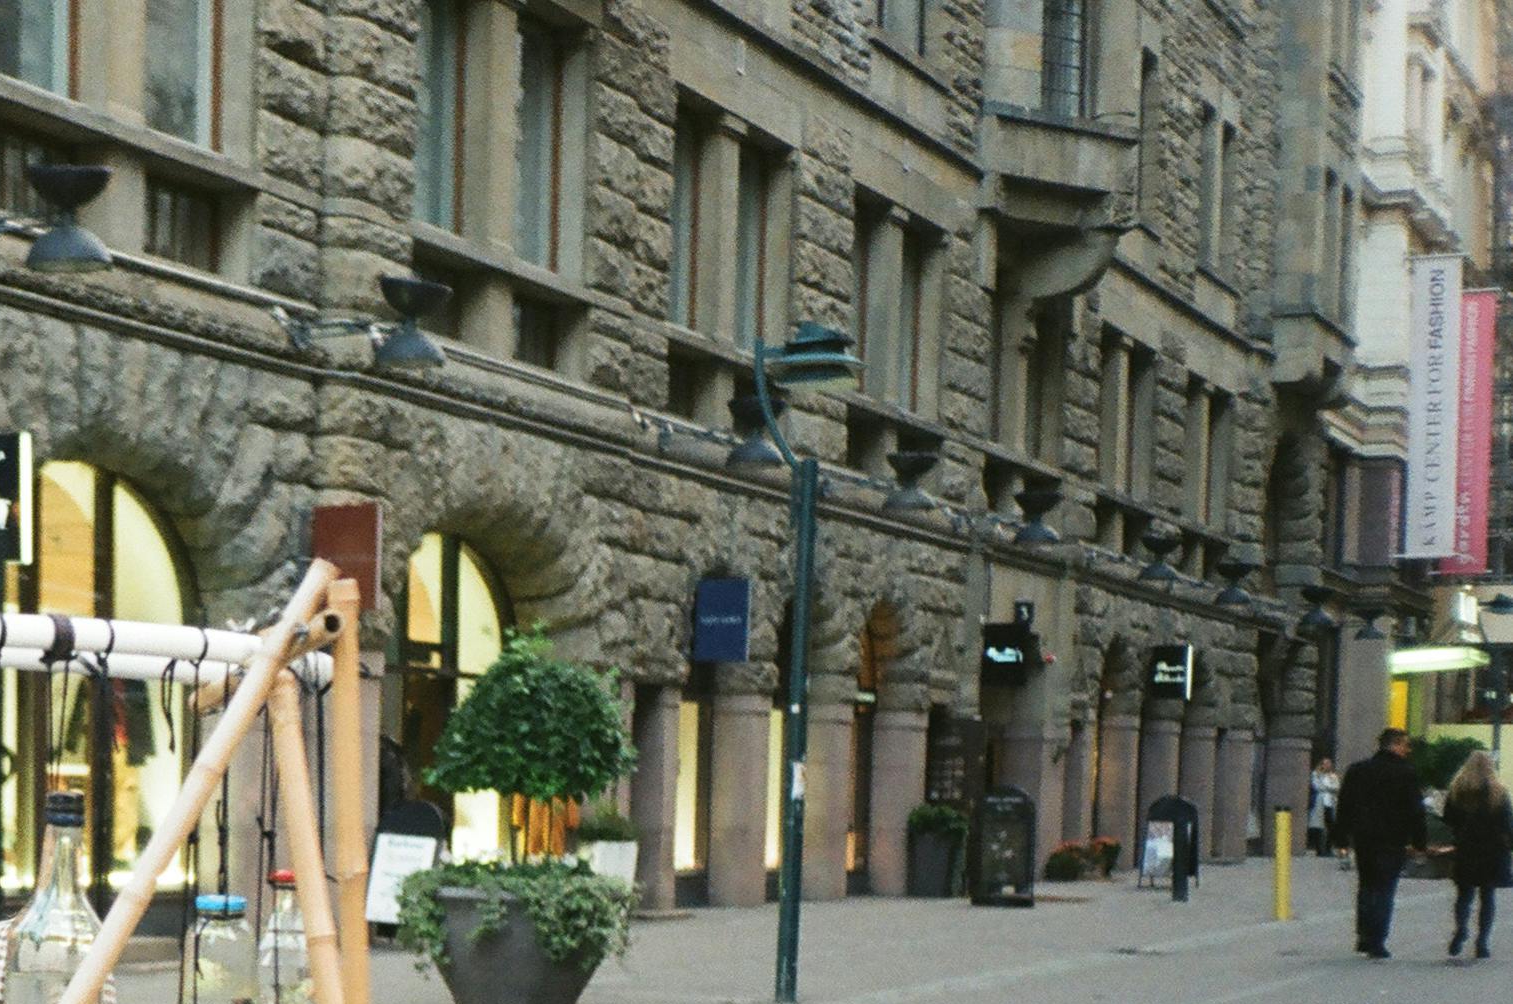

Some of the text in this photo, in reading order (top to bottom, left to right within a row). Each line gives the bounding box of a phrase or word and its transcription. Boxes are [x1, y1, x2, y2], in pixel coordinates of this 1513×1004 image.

[1429, 268, 1445, 350] FASHION
[1427, 355, 1443, 395] FOR
[1424, 402, 1442, 483] CENTER
